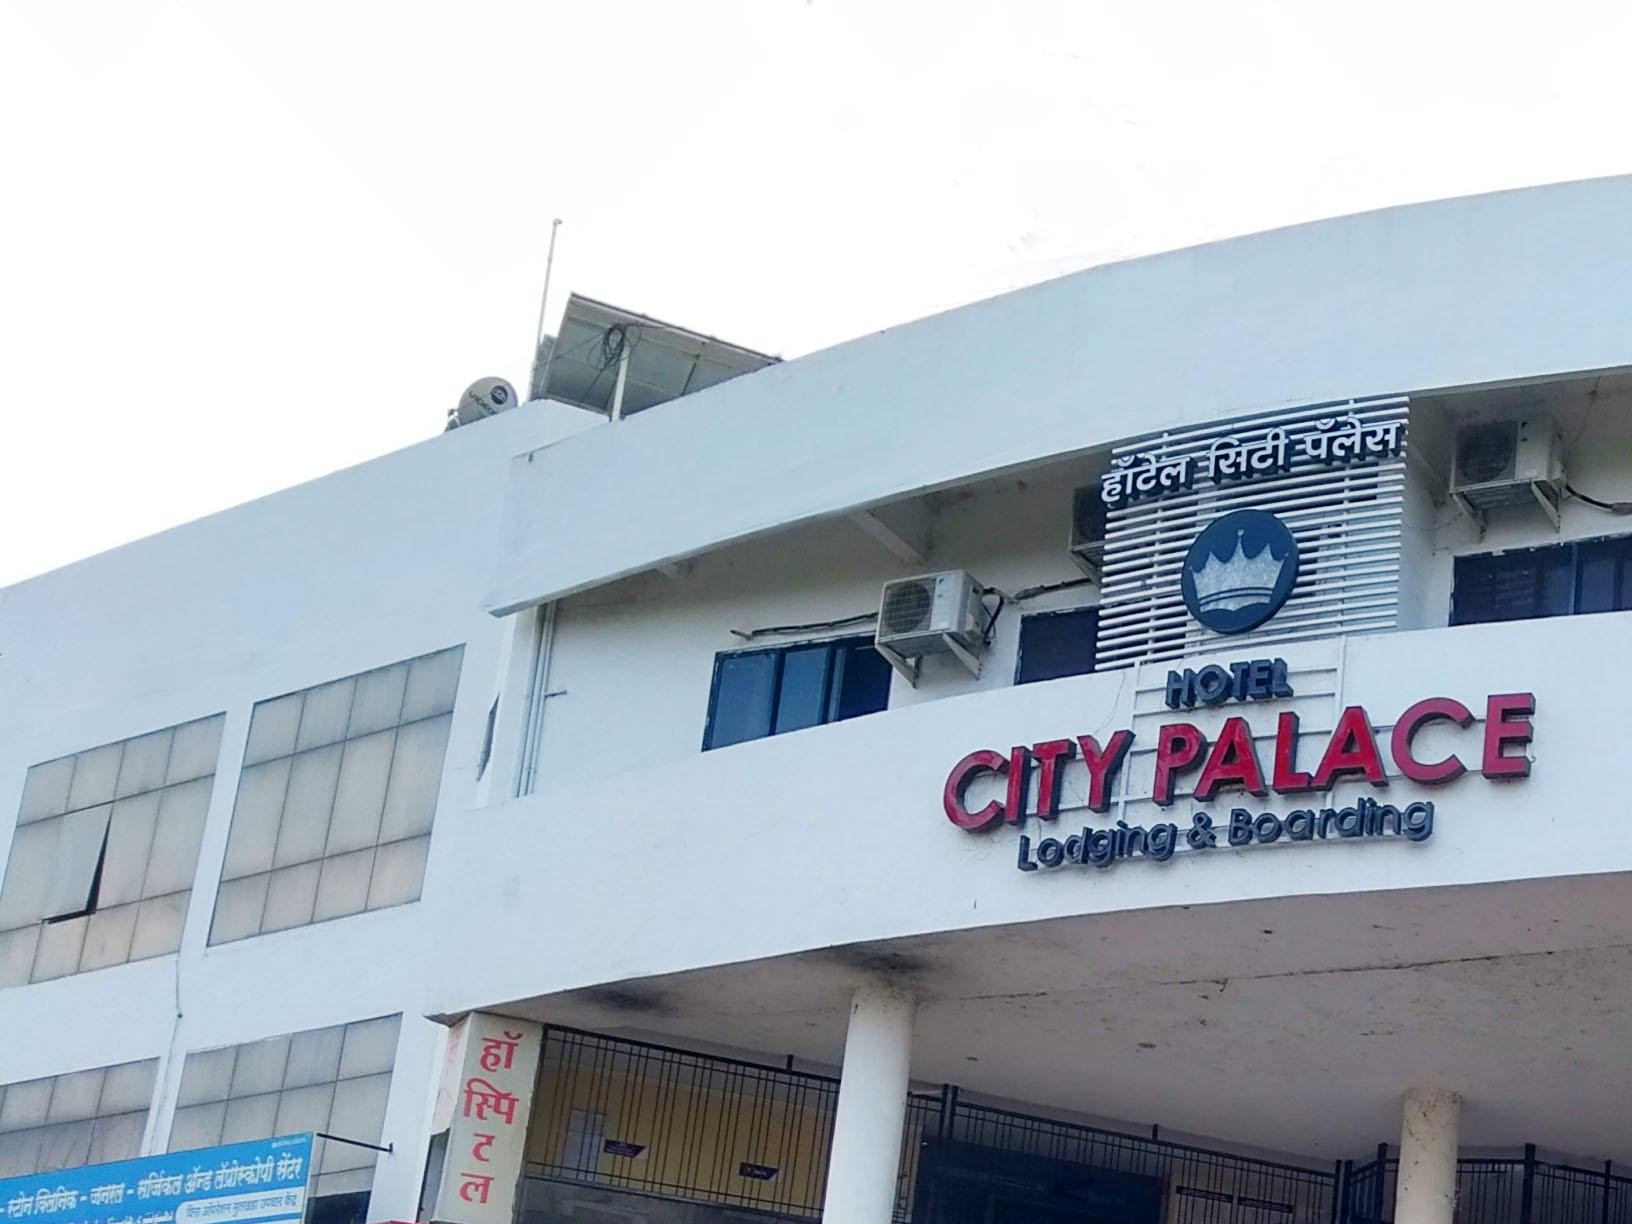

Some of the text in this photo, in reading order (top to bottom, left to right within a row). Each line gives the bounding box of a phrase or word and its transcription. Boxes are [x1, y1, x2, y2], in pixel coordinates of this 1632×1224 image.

[1101, 450, 1190, 503] हॉटेल
[1207, 425, 1289, 482] सिटी
[1165, 657, 1293, 710] HOTEL
[942, 692, 1536, 834] CITY PALACE
[1017, 797, 1435, 872] Lodging & Boarding
